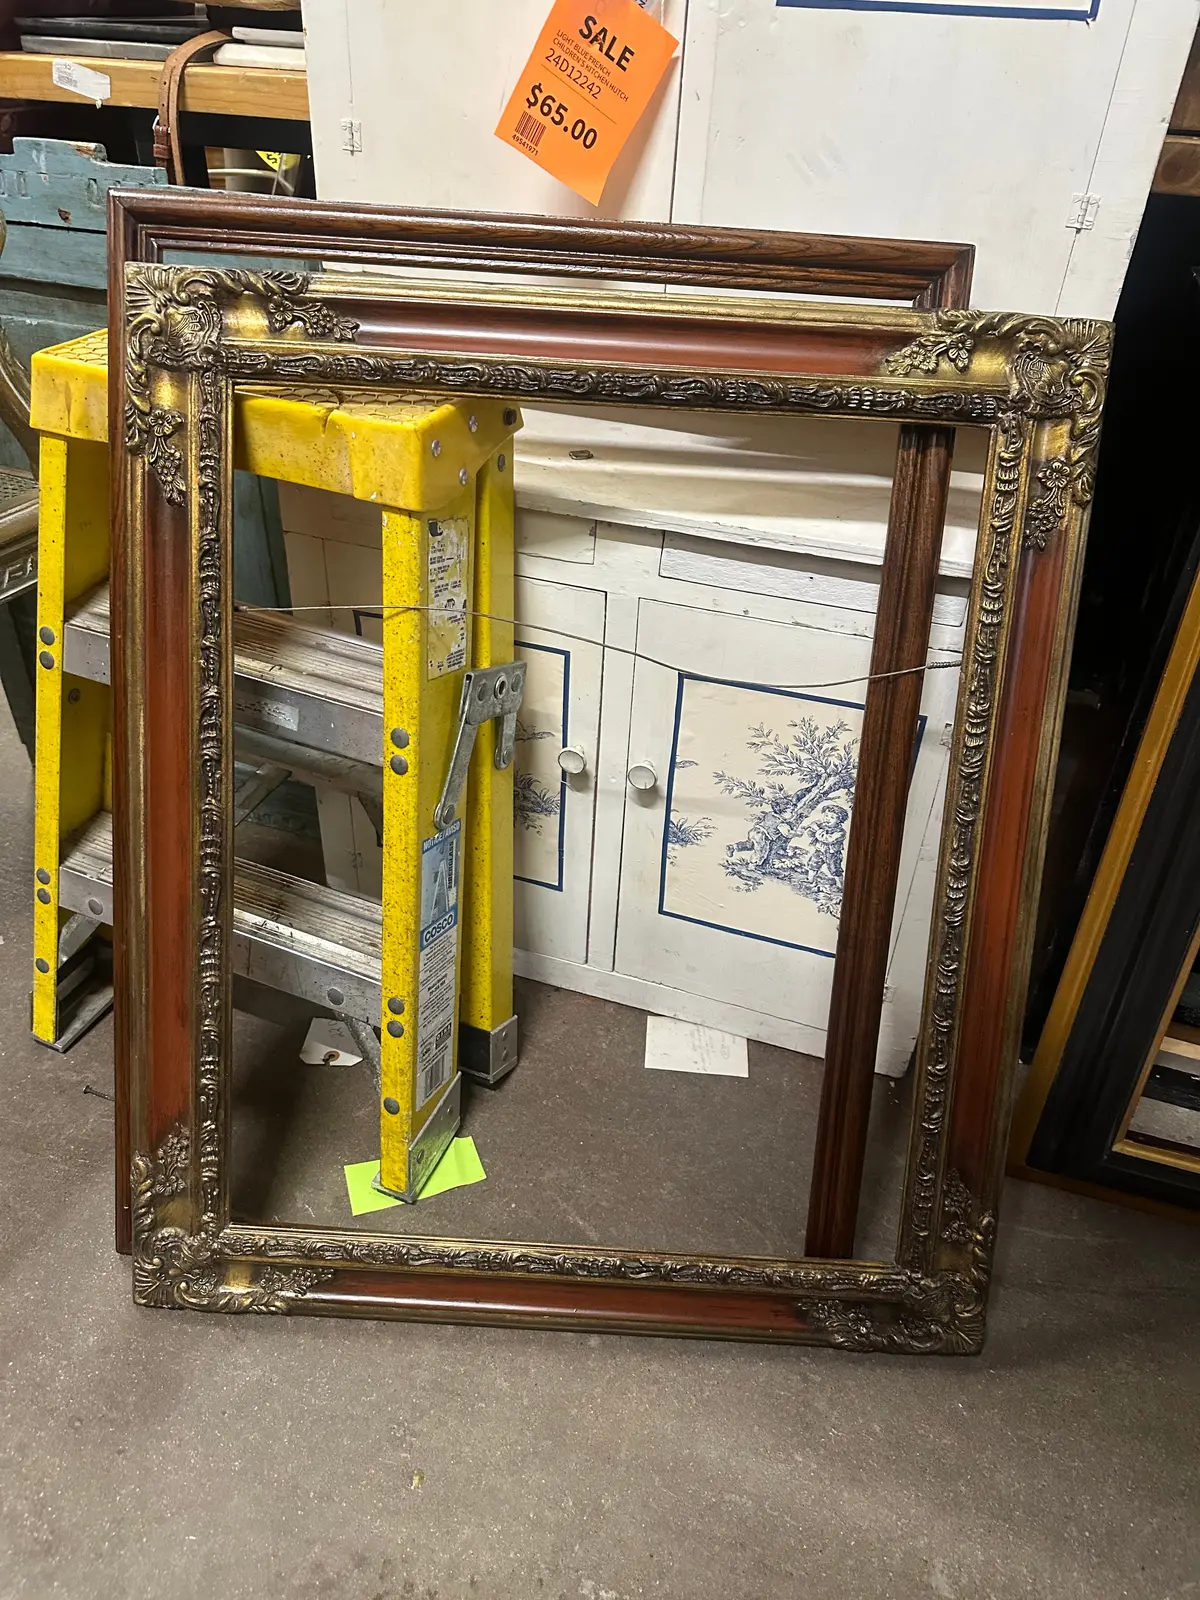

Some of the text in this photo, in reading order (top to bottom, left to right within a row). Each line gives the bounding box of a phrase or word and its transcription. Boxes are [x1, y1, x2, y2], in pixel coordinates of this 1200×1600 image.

[552, 37, 629, 102] CHILDREN'S KITCHEN HUTCH
[556, 29, 611, 77] LIGHT BLUE FRENCH
[578, 15, 635, 72] SALE
[545, 47, 602, 100] 24D12242
[525, 82, 598, 150] $65.00
[511, 134, 539, 156] 49541971
[424, 913, 453, 943] COSCO
